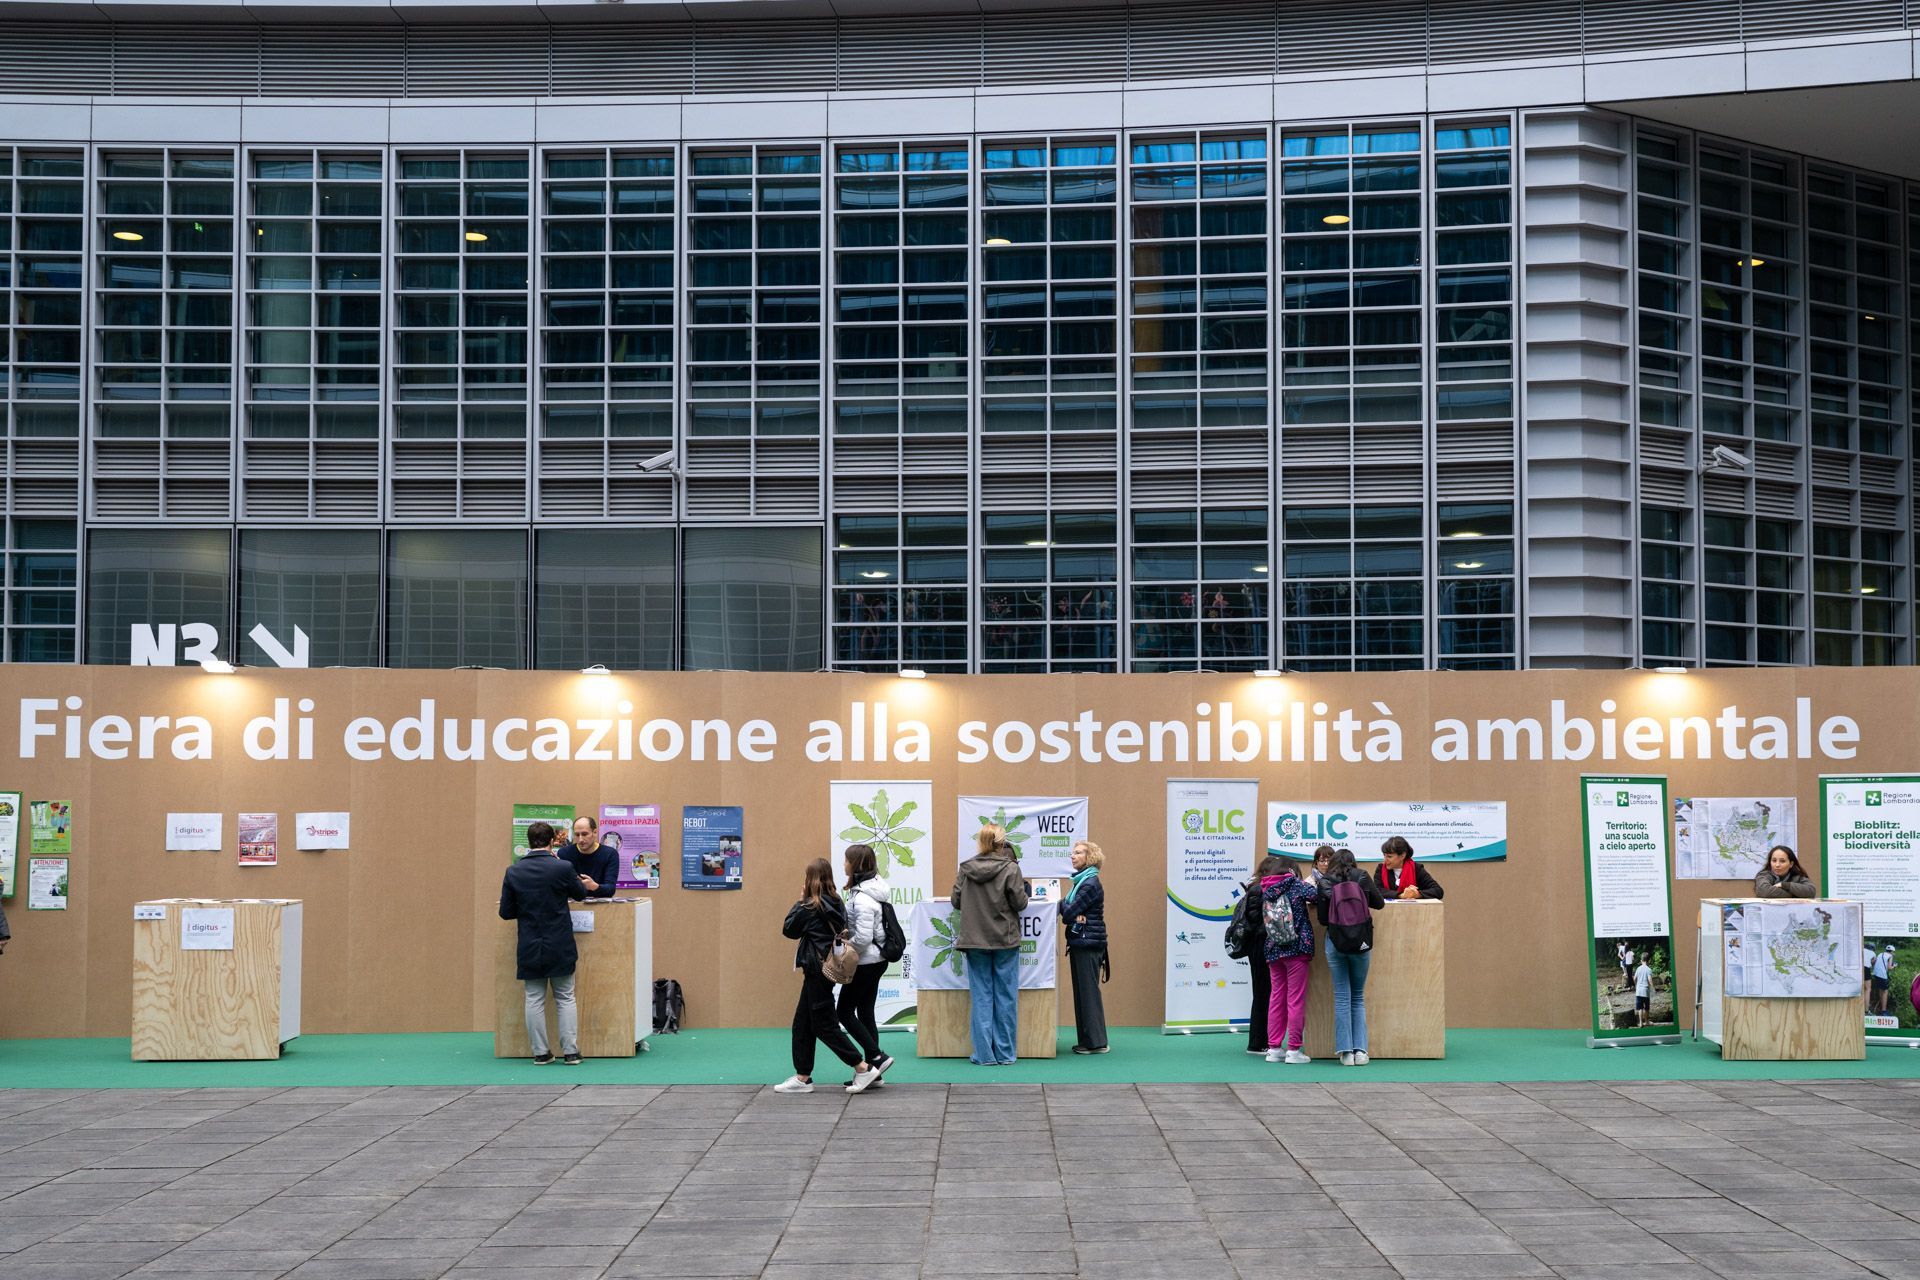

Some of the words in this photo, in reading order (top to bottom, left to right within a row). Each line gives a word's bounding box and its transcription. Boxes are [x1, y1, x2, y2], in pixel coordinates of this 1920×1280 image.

[19, 695, 213, 760] Fiera
[243, 697, 315, 761] di
[343, 698, 778, 762] educazione
[805, 701, 931, 763] alla
[957, 701, 1402, 763] sostenibilità
[1431, 697, 1860, 761] ambientale
[600, 819, 632, 827] progetto
[684, 817, 707, 828] REBOT
[1037, 815, 1075, 833] WEEC
[1182, 809, 1245, 833] CLIC
[1606, 821, 1647, 830] Territorio:
[1854, 821, 1900, 829] Bioblitz:
[179, 826, 204, 835] digitus
[1276, 813, 1348, 840] CLIC
[316, 827, 339, 836] stripes
[1622, 832, 1649, 840] scuola
[1833, 831, 1892, 840] esploratori
[1896, 831, 1920, 839] della
[1042, 837, 1069, 846] Network
[1844, 840, 1911, 849] biodiversità
[1606, 842, 1626, 850] cielo
[1628, 843, 1656, 852] aperto
[1039, 849, 1054, 857] Rete
[1207, 849, 1226, 857] digitali
[890, 888, 923, 904] TALIA
[192, 924, 218, 932] digitus
[1020, 916, 1041, 937] EC
